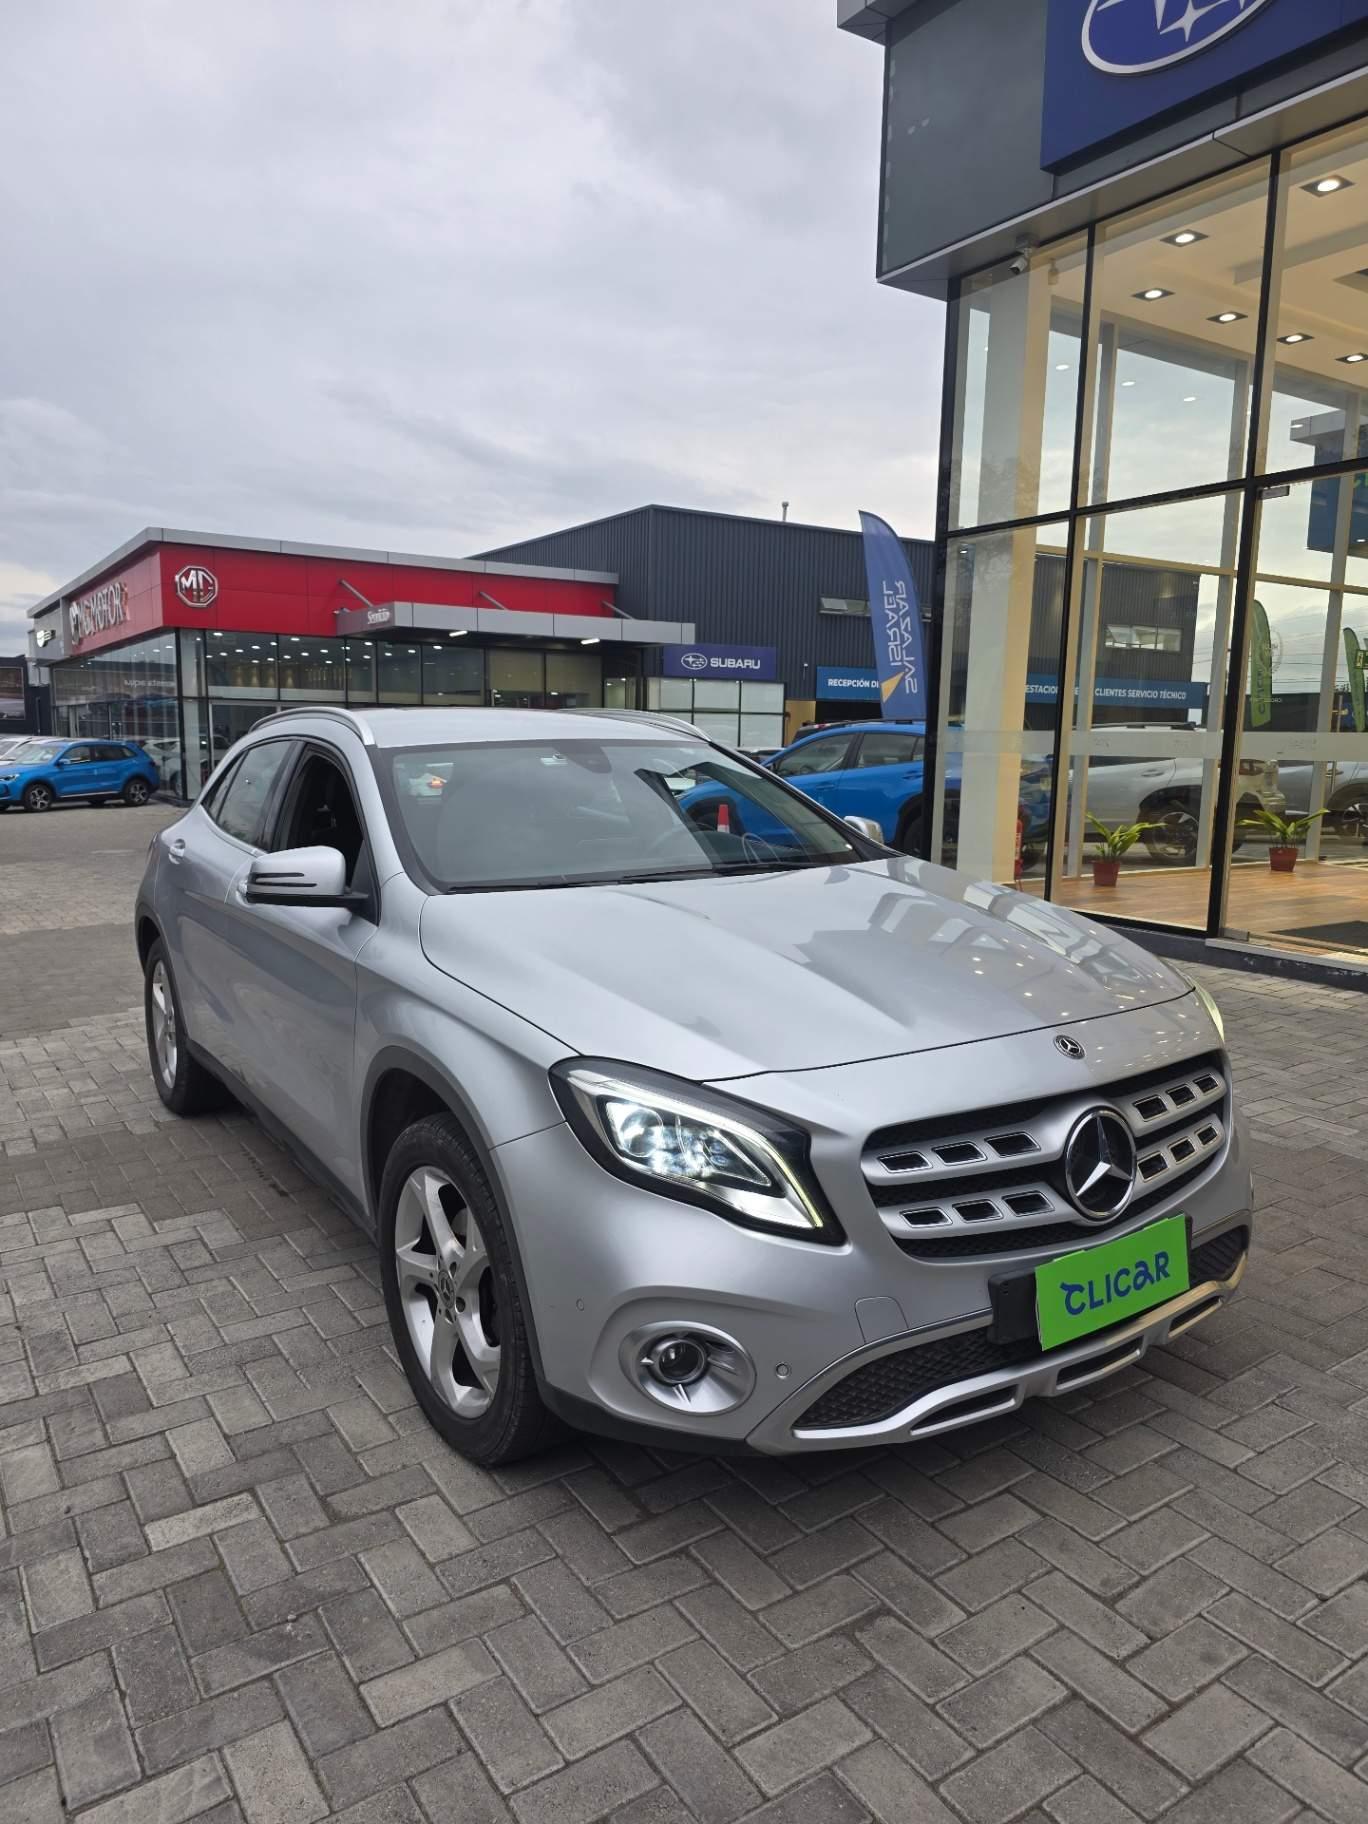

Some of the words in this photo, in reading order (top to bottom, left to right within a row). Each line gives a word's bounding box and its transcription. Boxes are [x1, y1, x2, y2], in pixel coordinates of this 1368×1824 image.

[179, 568, 215, 604] MG
[710, 657, 761, 670] SUBARU
[827, 677, 870, 688] RECEPCIÓN
[1024, 684, 1058, 695] ESTACIO
[1094, 687, 1127, 697] CLIENTES
[1127, 689, 1159, 699] SERVICIO
[1159, 689, 1187, 700] TÉCNICO
